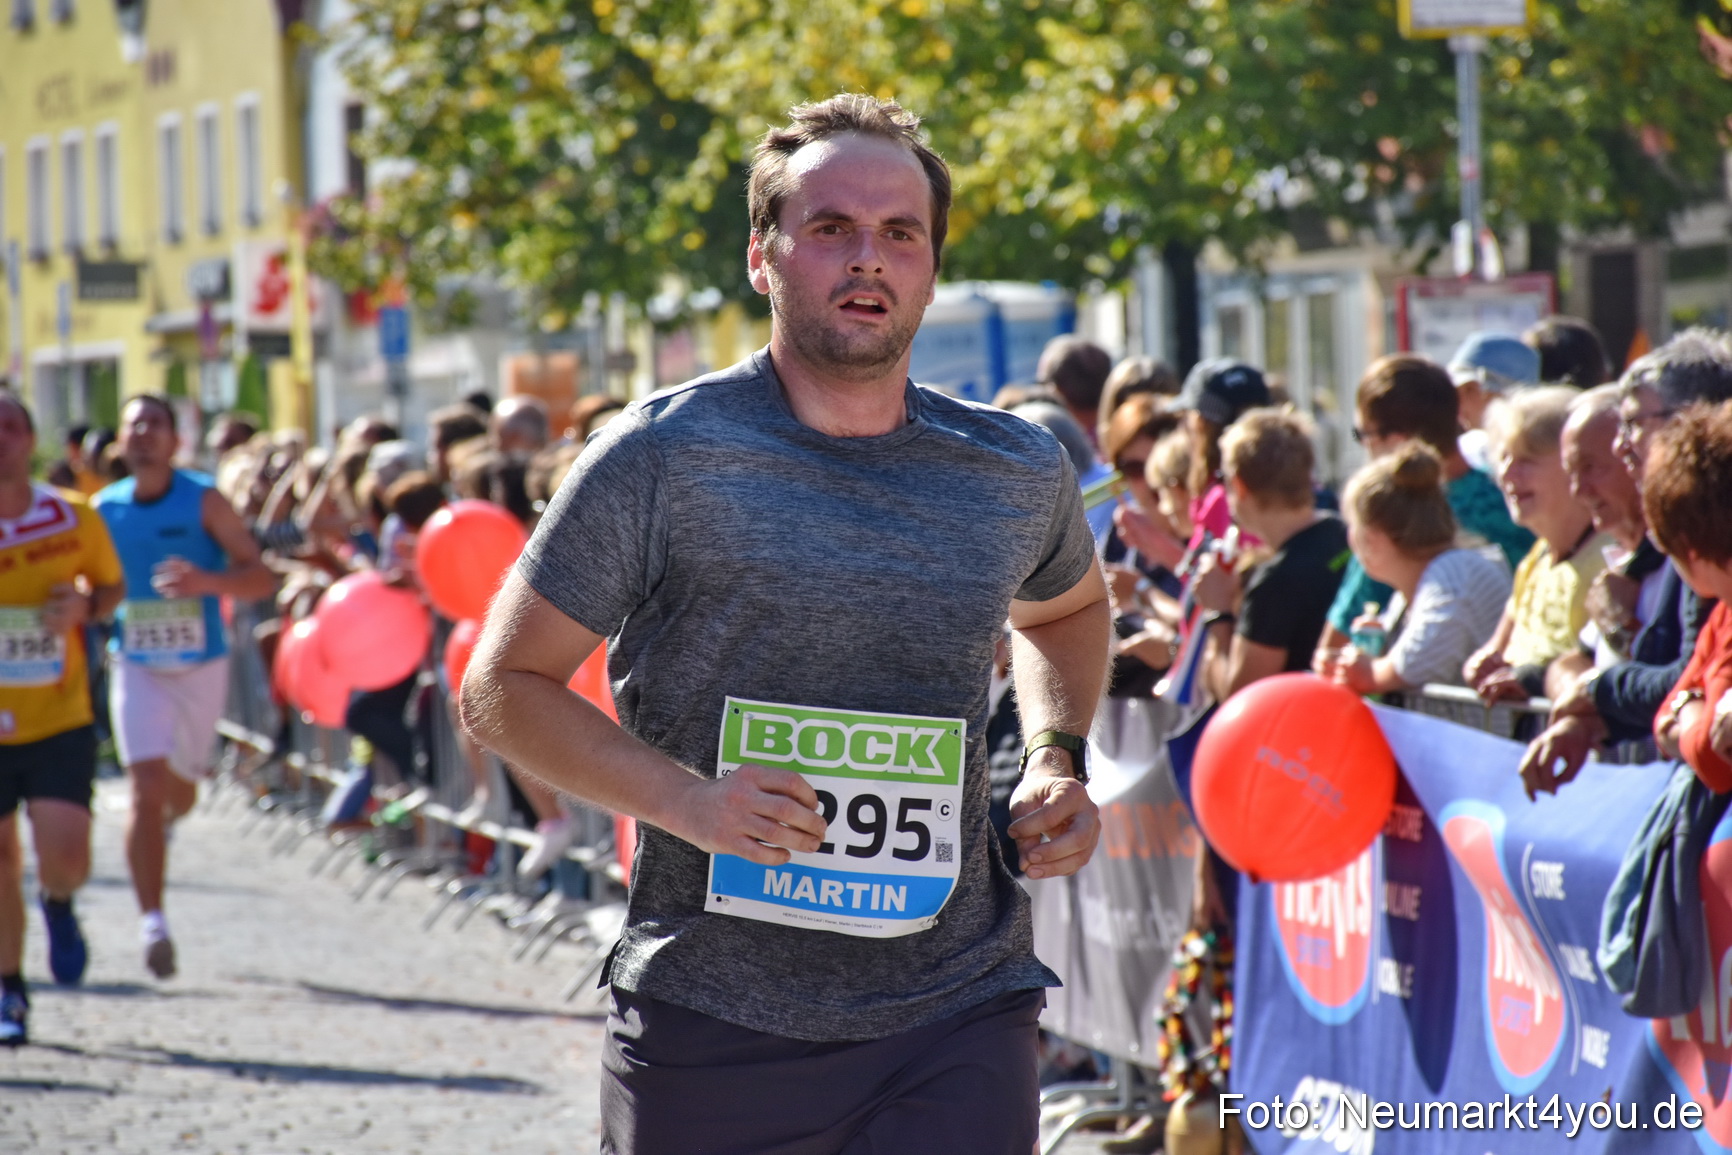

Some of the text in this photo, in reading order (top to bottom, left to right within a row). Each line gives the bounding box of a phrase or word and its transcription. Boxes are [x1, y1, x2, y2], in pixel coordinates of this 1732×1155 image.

[740, 711, 945, 776] BOCK
[755, 789, 933, 861] 295
[763, 869, 907, 912] MARTIN
[1531, 860, 1566, 900] STORE
